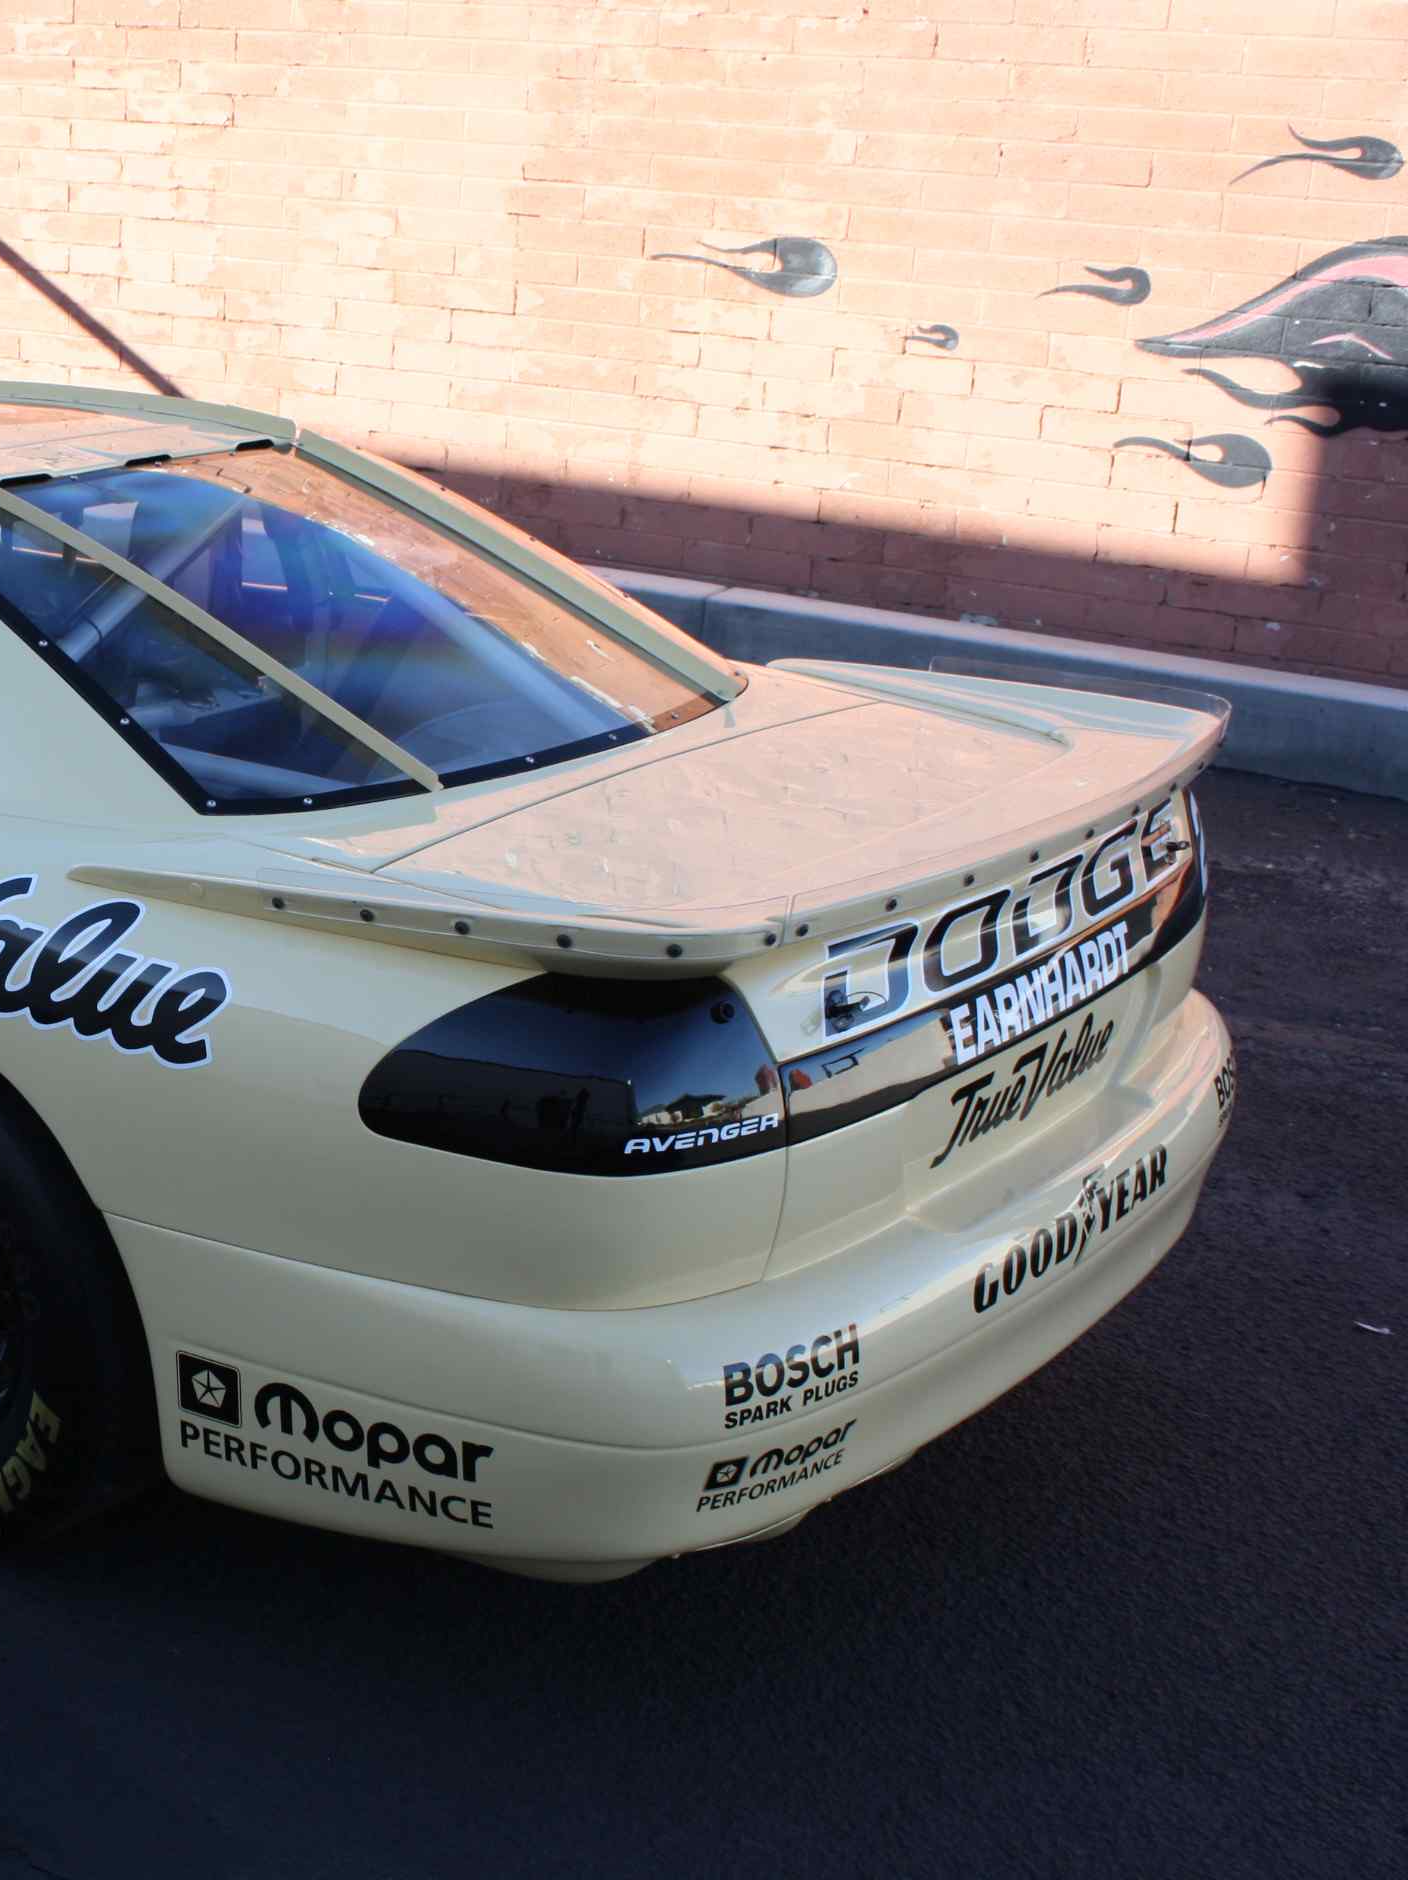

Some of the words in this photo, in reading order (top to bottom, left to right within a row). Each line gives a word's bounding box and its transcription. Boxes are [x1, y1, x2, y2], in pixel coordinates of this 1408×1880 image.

[823, 797, 1180, 1040] DODGE
[949, 919, 1131, 1066] EARNHARDT
[624, 1113, 780, 1156] AVENGER
[930, 1070, 1029, 1169] True
[1012, 1012, 1114, 1121] Value
[723, 1322, 861, 1408] BOSCH
[724, 1394, 793, 1430] SPARK
[802, 1370, 859, 1406] PLUGS
[180, 1420, 495, 1530] PERFORMANCE
[696, 1448, 845, 1513] PERFORMANCE
